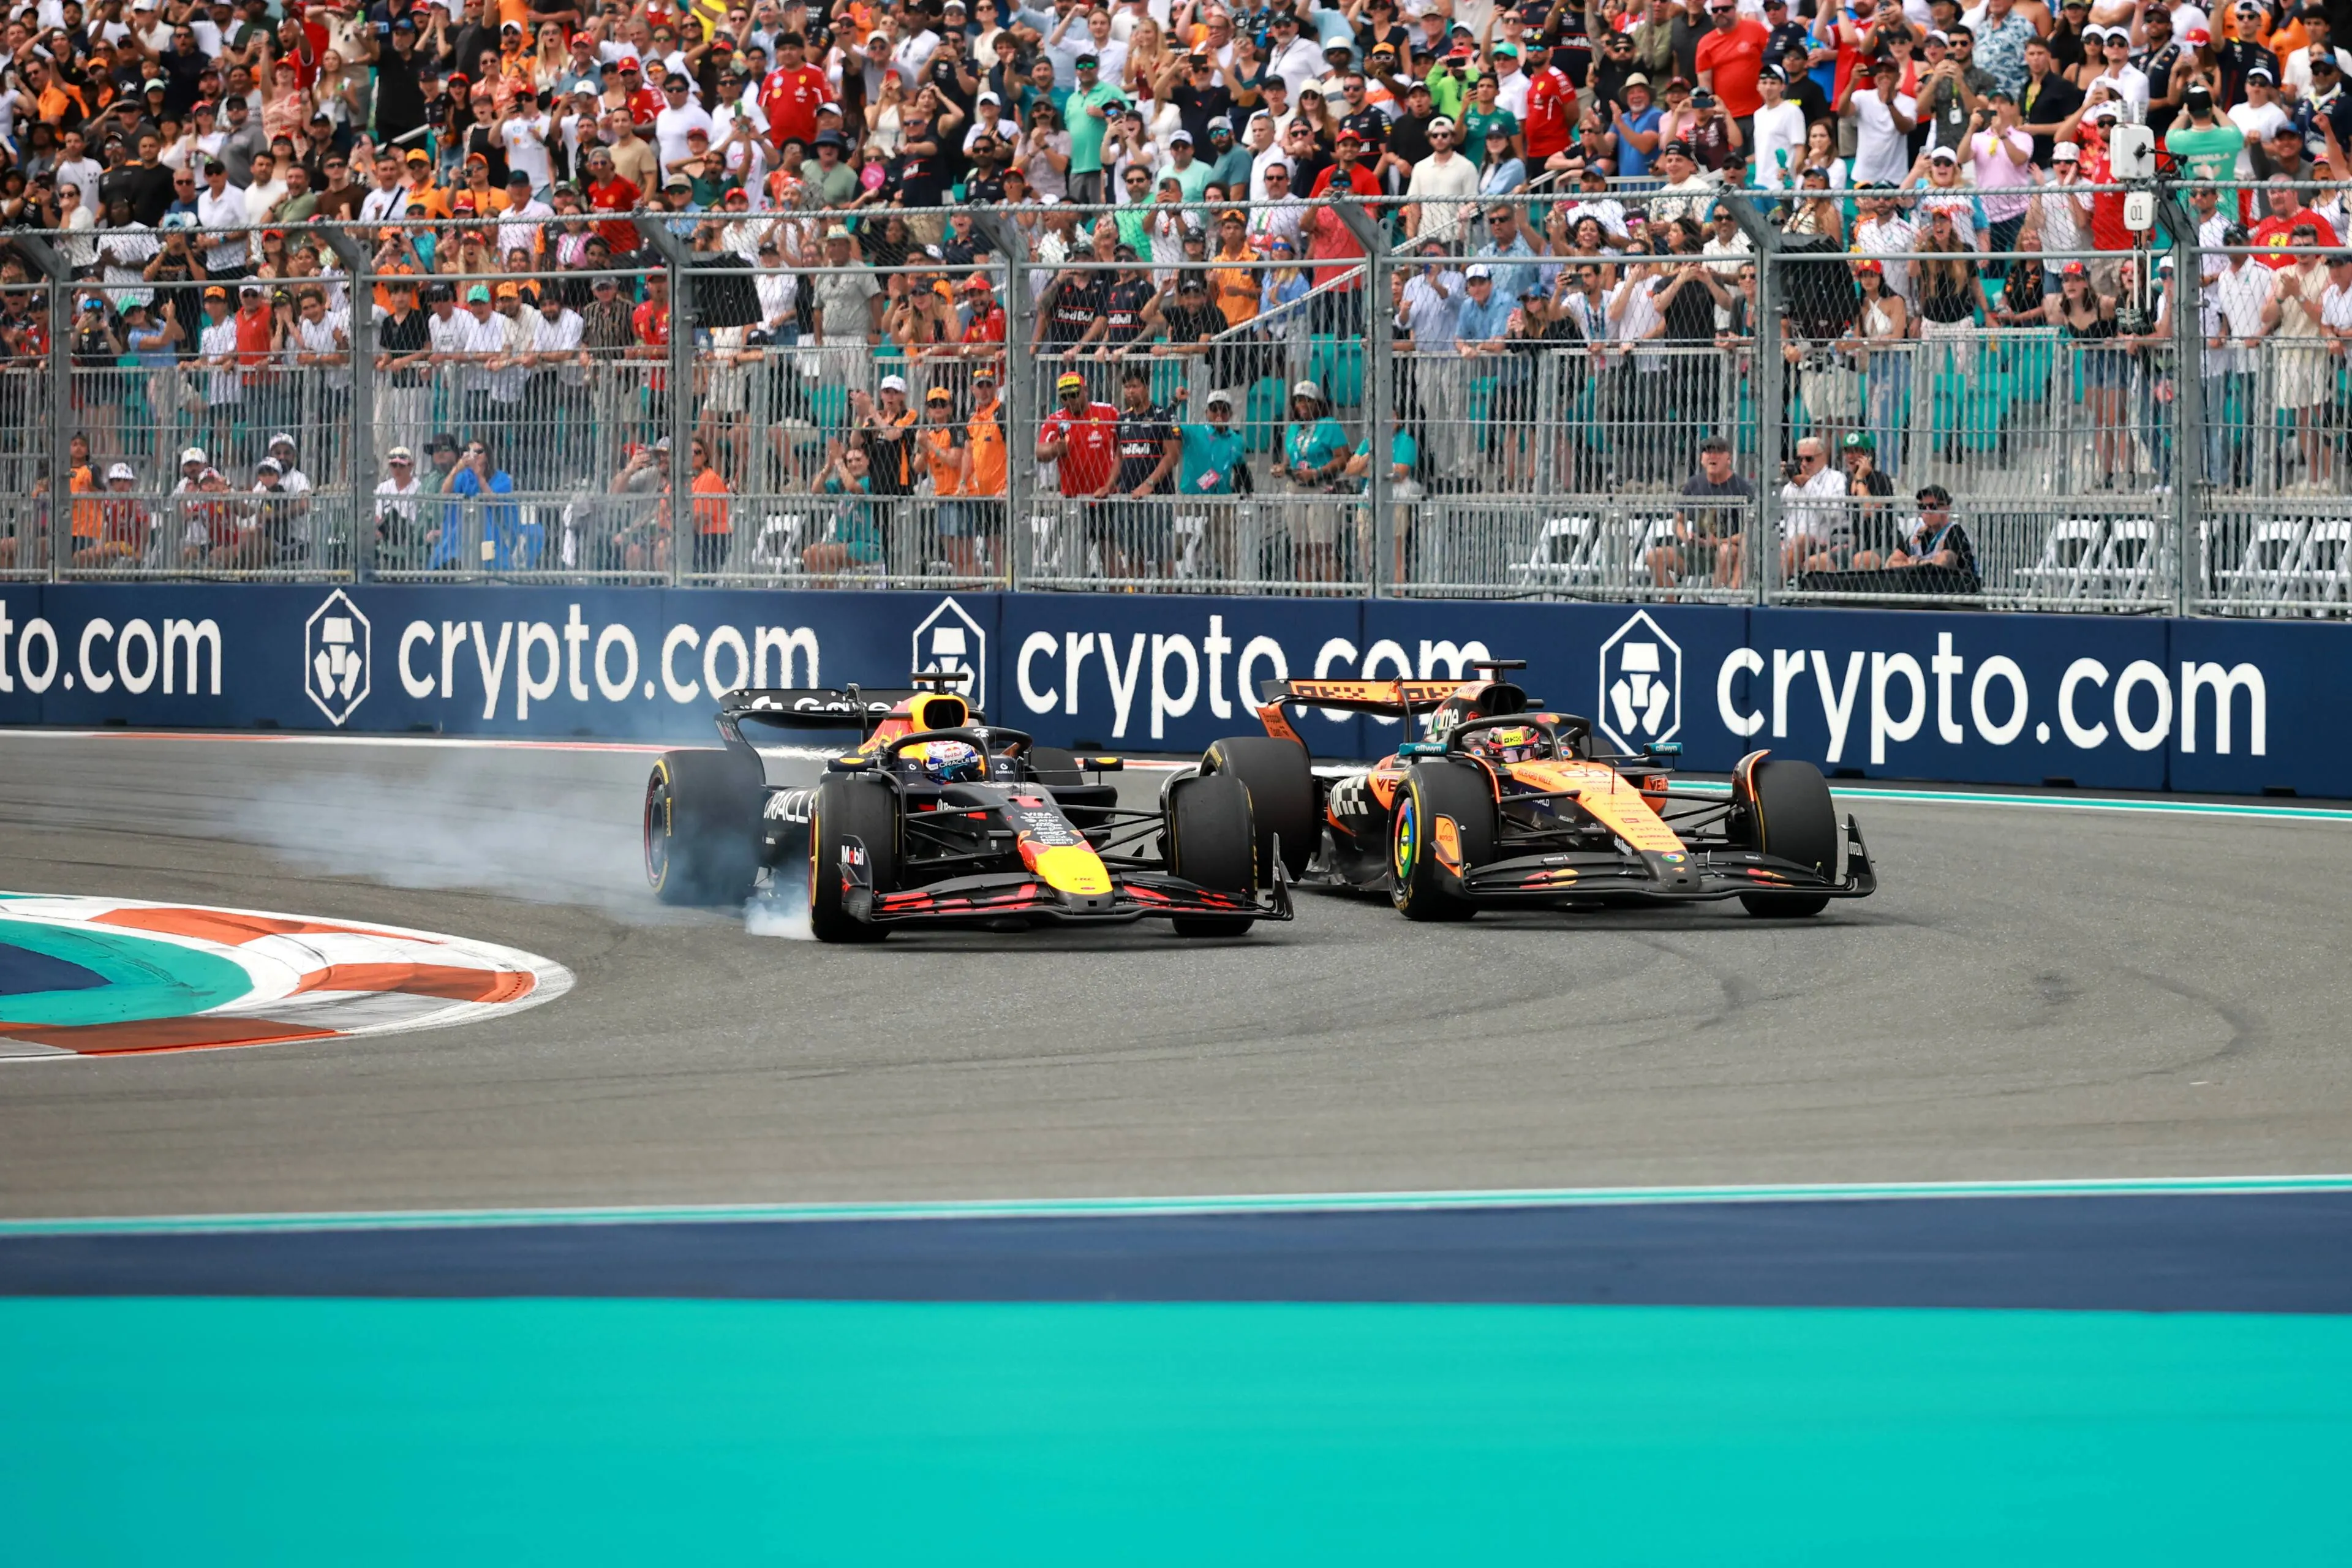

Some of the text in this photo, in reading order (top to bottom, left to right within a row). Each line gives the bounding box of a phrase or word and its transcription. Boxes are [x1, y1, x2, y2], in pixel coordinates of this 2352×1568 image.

[2130, 205, 2143, 221] 01
[399, 603, 820, 721] crypto.com
[1717, 631, 2266, 764] crypto.com
[1414, 744, 1442, 753] allwyn
[1656, 744, 1678, 753] allwyn
[939, 758, 970, 767] ORACLE
[841, 845, 864, 866] Mobil
